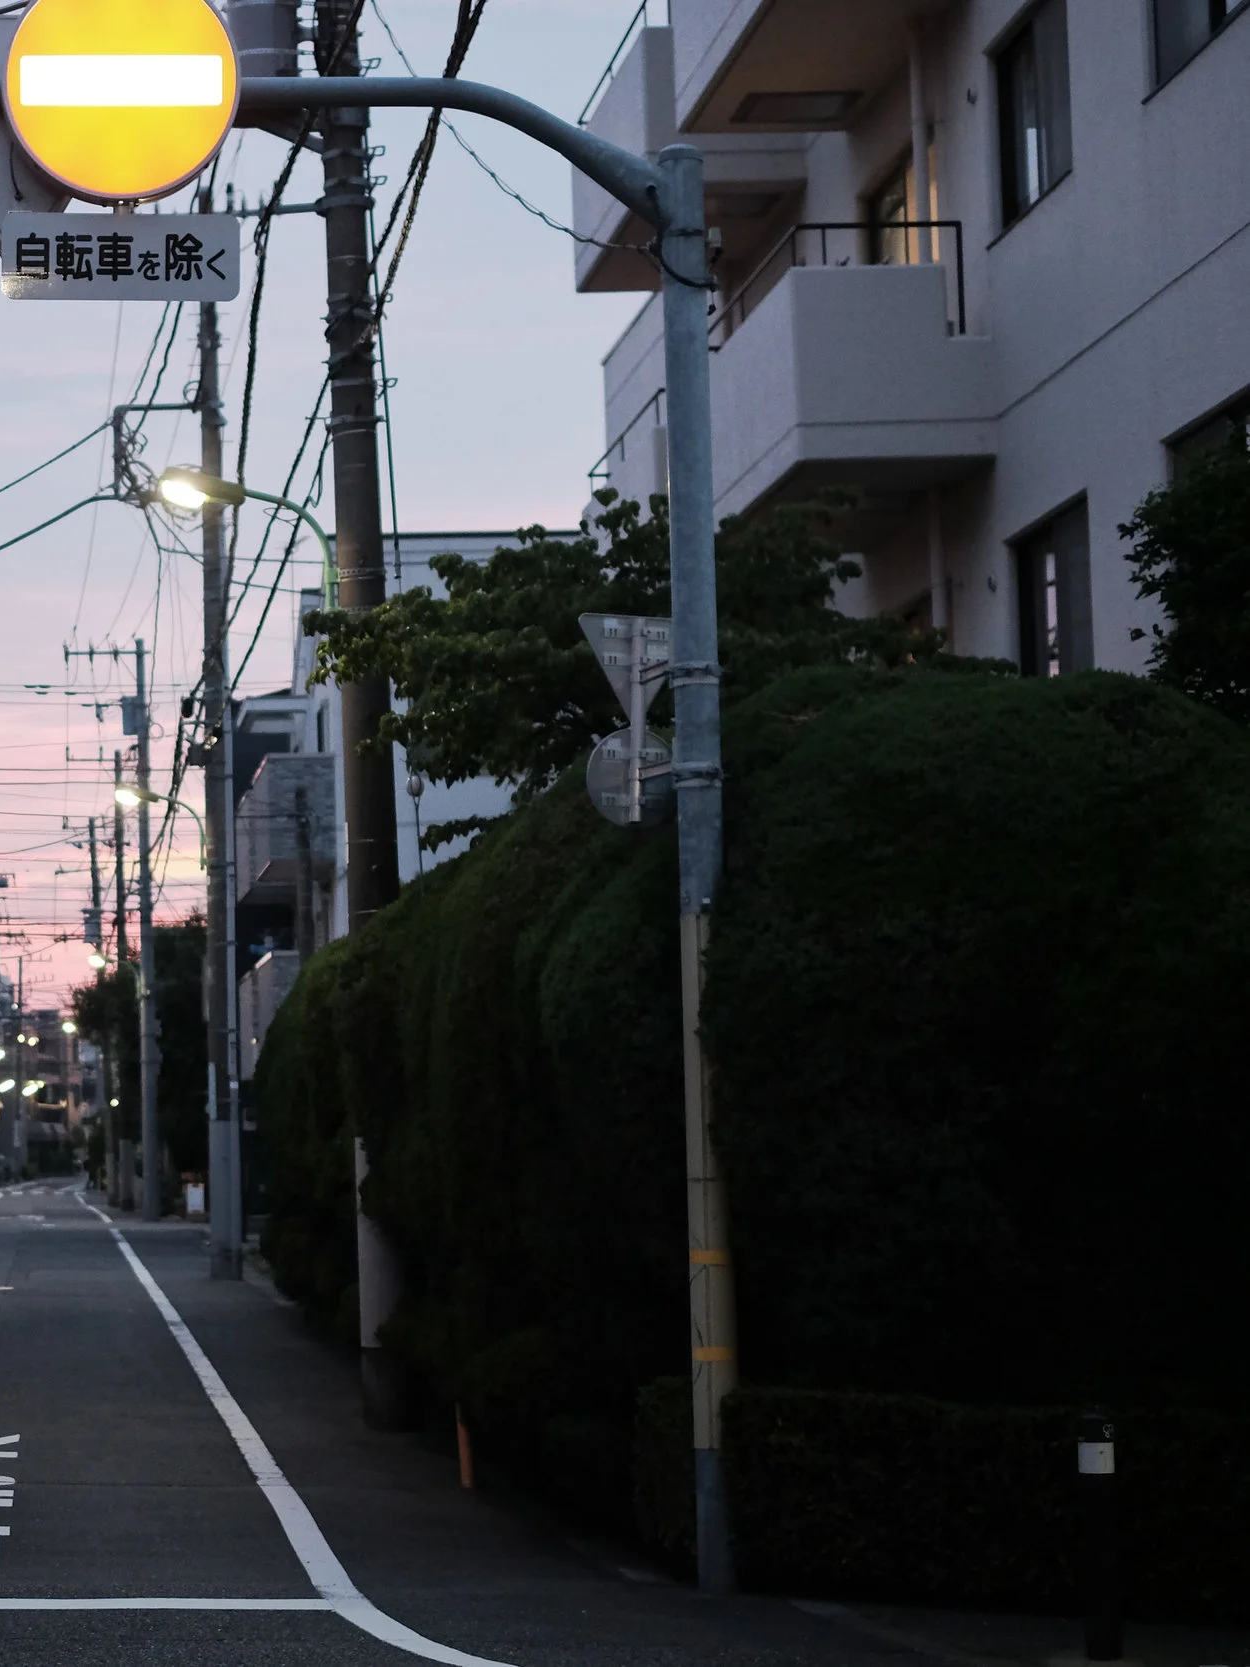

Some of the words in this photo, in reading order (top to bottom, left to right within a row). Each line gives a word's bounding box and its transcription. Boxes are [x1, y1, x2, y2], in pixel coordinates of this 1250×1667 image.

[16, 232, 226, 282] 自転車を除く
